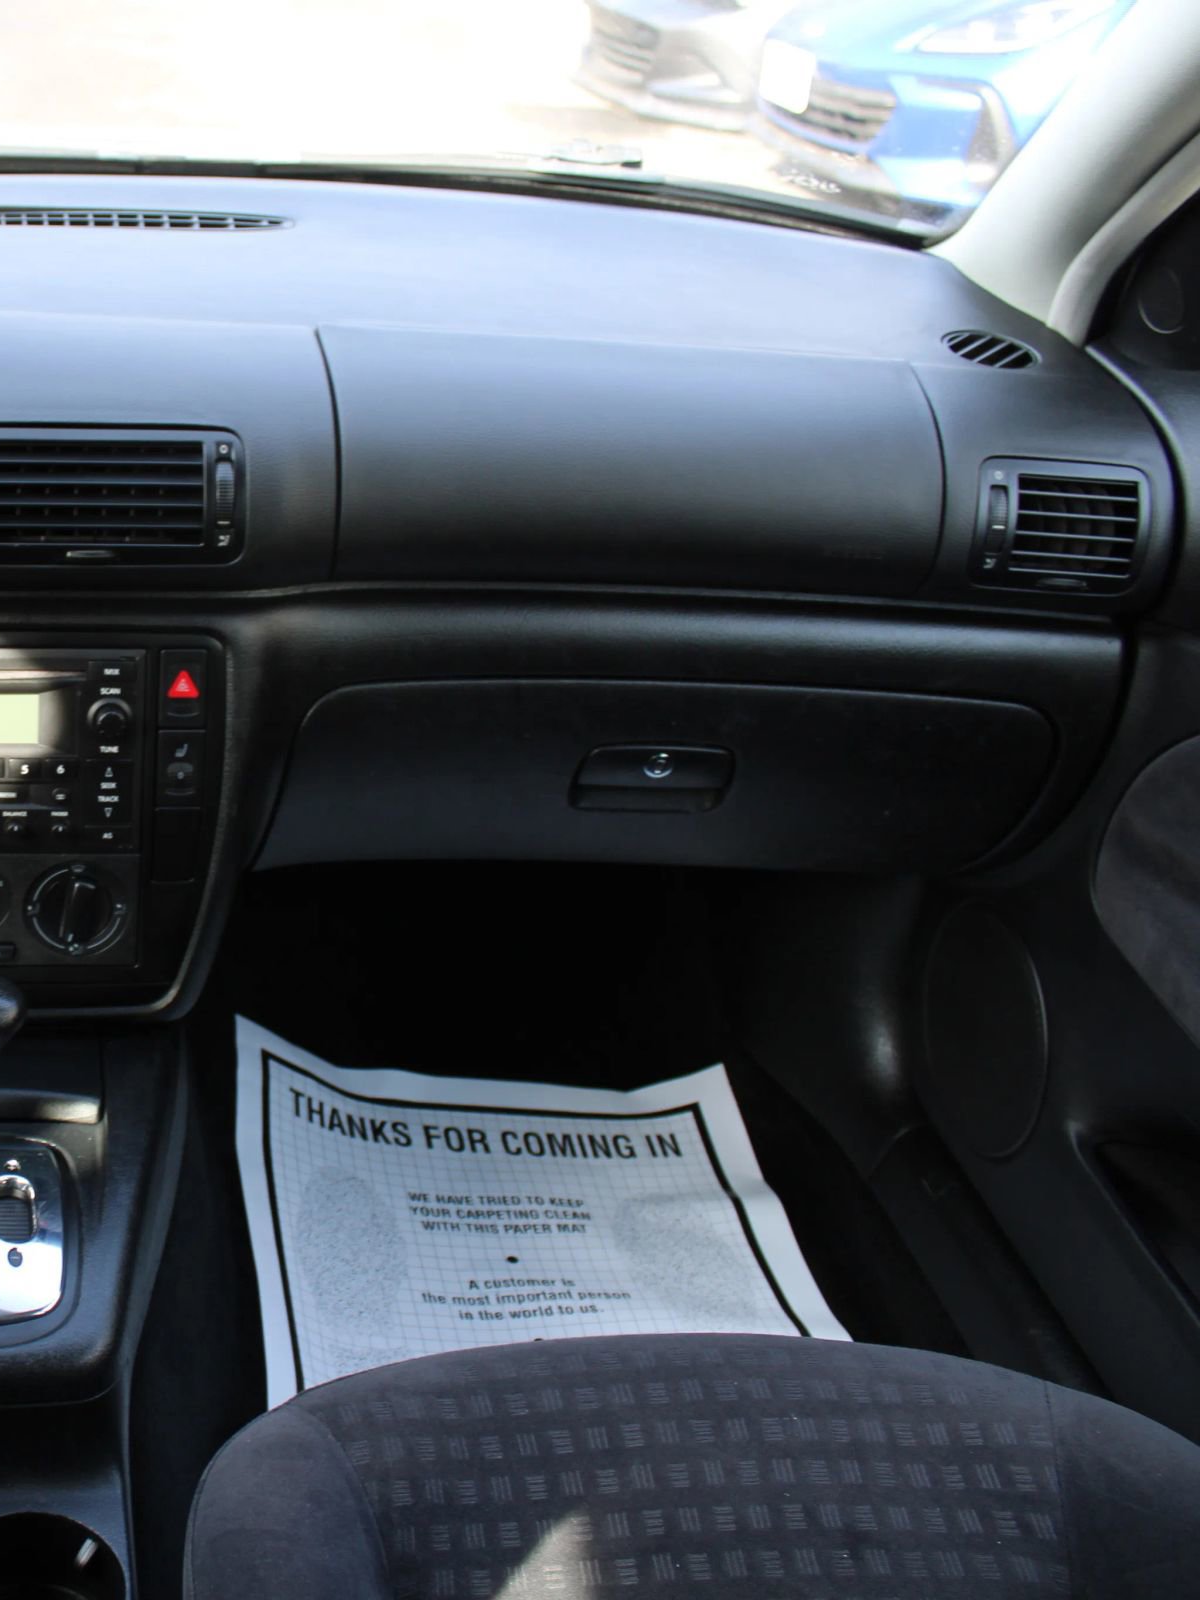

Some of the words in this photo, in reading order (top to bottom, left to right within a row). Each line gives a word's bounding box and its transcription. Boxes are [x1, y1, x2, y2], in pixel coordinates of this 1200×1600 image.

[20, 763, 29, 775] 5
[56, 763, 65, 775] 6
[289, 1086, 413, 1148] THANKS
[422, 1124, 492, 1154] FOR
[501, 1130, 637, 1159] COMING
[645, 1132, 683, 1158] IN
[408, 1192, 430, 1203] WE
[435, 1193, 474, 1206] HAVE
[476, 1195, 522, 1207] TRIED
[525, 1196, 545, 1207] TO
[550, 1198, 585, 1209] KEEP
[409, 1206, 452, 1218] YOUR
[455, 1208, 540, 1221] CARPETING
[544, 1209, 592, 1222] CLEAN
[421, 1220, 461, 1232] WITH
[466, 1222, 500, 1235] THIS
[503, 1223, 553, 1235] PAPER
[557, 1223, 588, 1234] MAT
[468, 1279, 480, 1291] A
[483, 1277, 557, 1290] customer
[561, 1277, 577, 1288] is
[421, 1291, 447, 1305] the
[451, 1293, 492, 1306] most
[495, 1289, 573, 1306] important
[576, 1291, 631, 1303] person
[458, 1309, 474, 1321] in
[478, 1307, 504, 1321] the
[508, 1305, 554, 1320] world
[558, 1304, 575, 1316] to
[579, 1303, 605, 1315] us.
